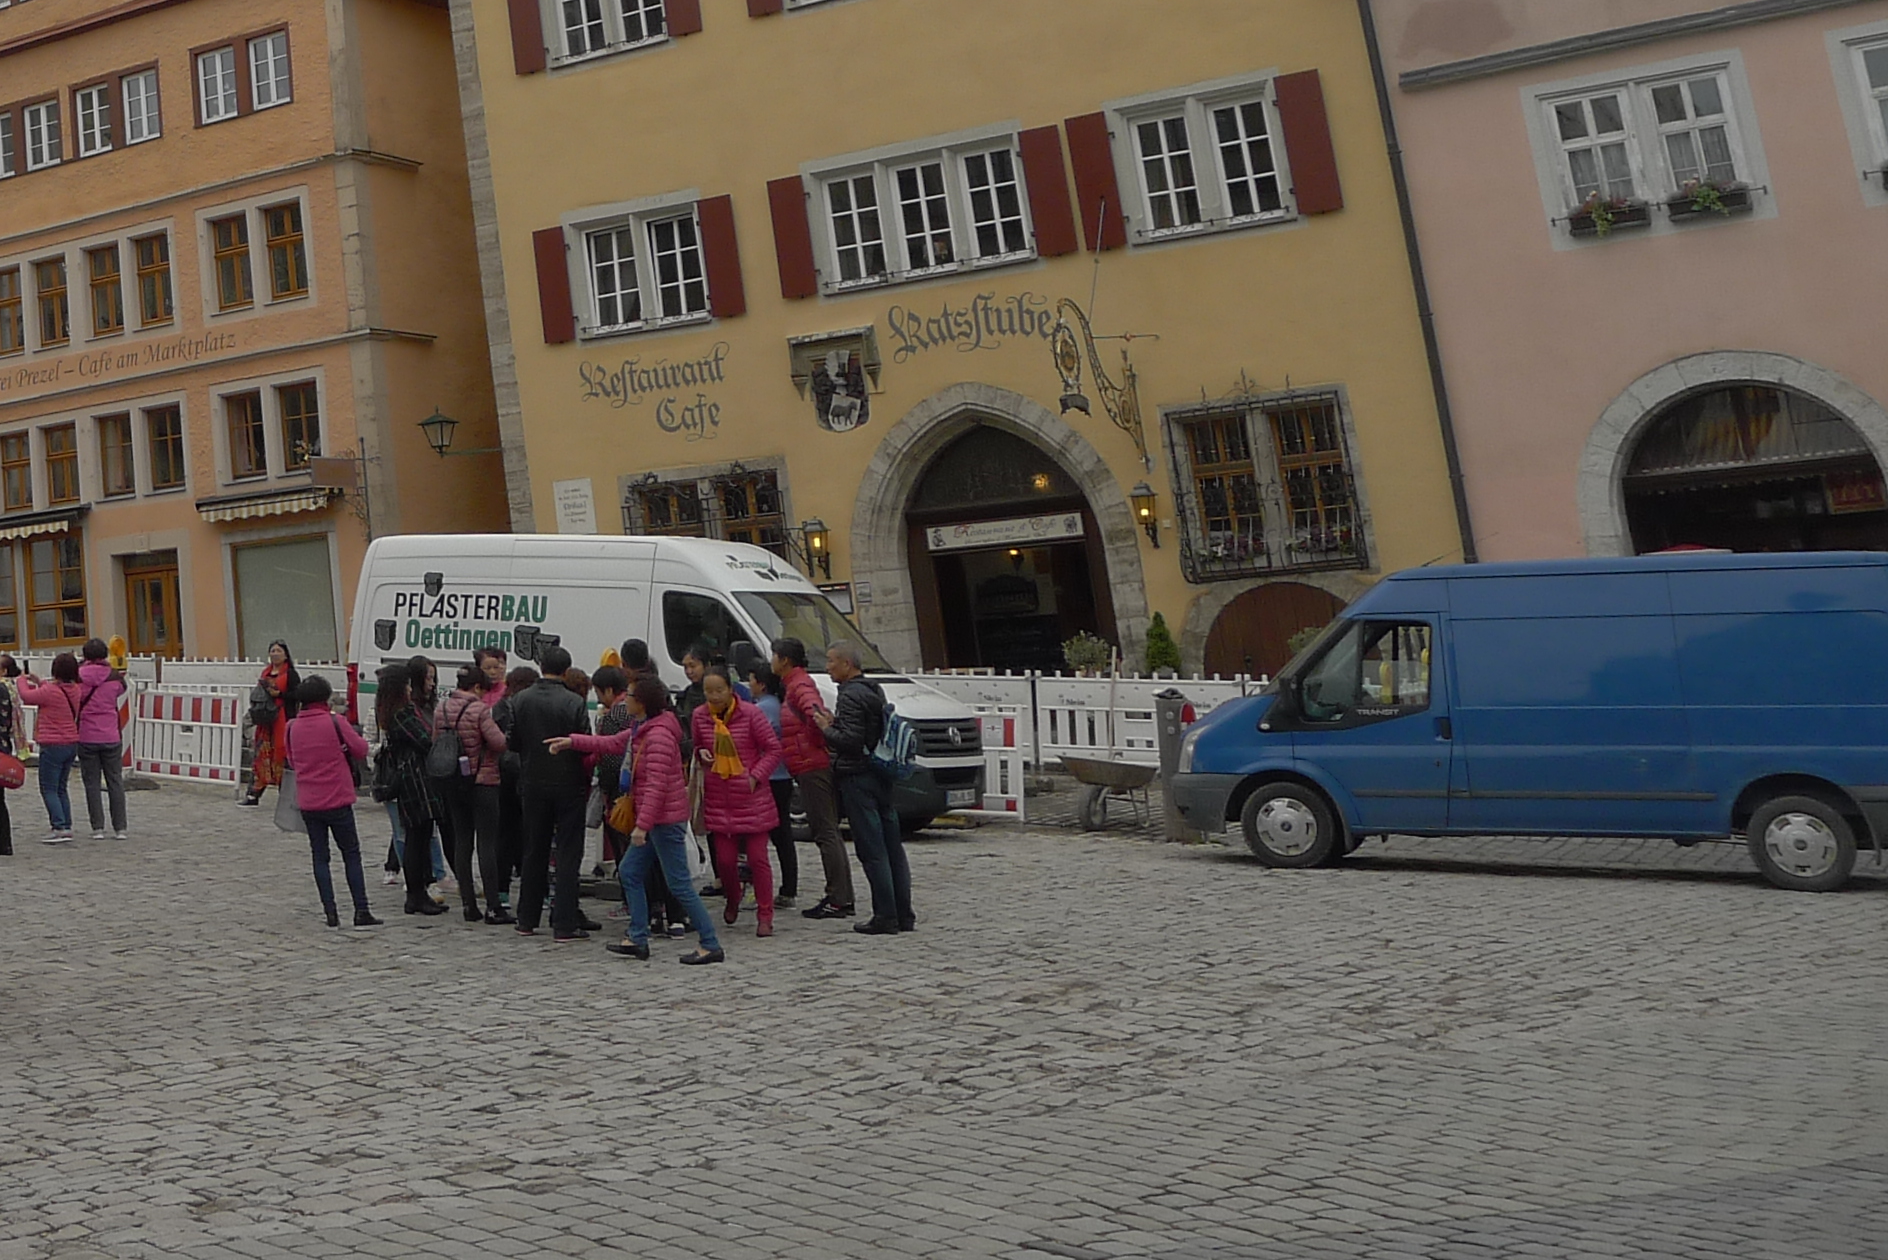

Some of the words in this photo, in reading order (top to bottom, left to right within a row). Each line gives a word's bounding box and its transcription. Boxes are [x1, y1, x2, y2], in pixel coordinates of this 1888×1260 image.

[17, 360, 62, 387] Prezel
[78, 350, 112, 377] Café
[116, 352, 138, 369] am
[143, 331, 236, 366] Marktplatz
[394, 592, 548, 623] PFLASTERBAU
[405, 620, 512, 652] Oettingen
